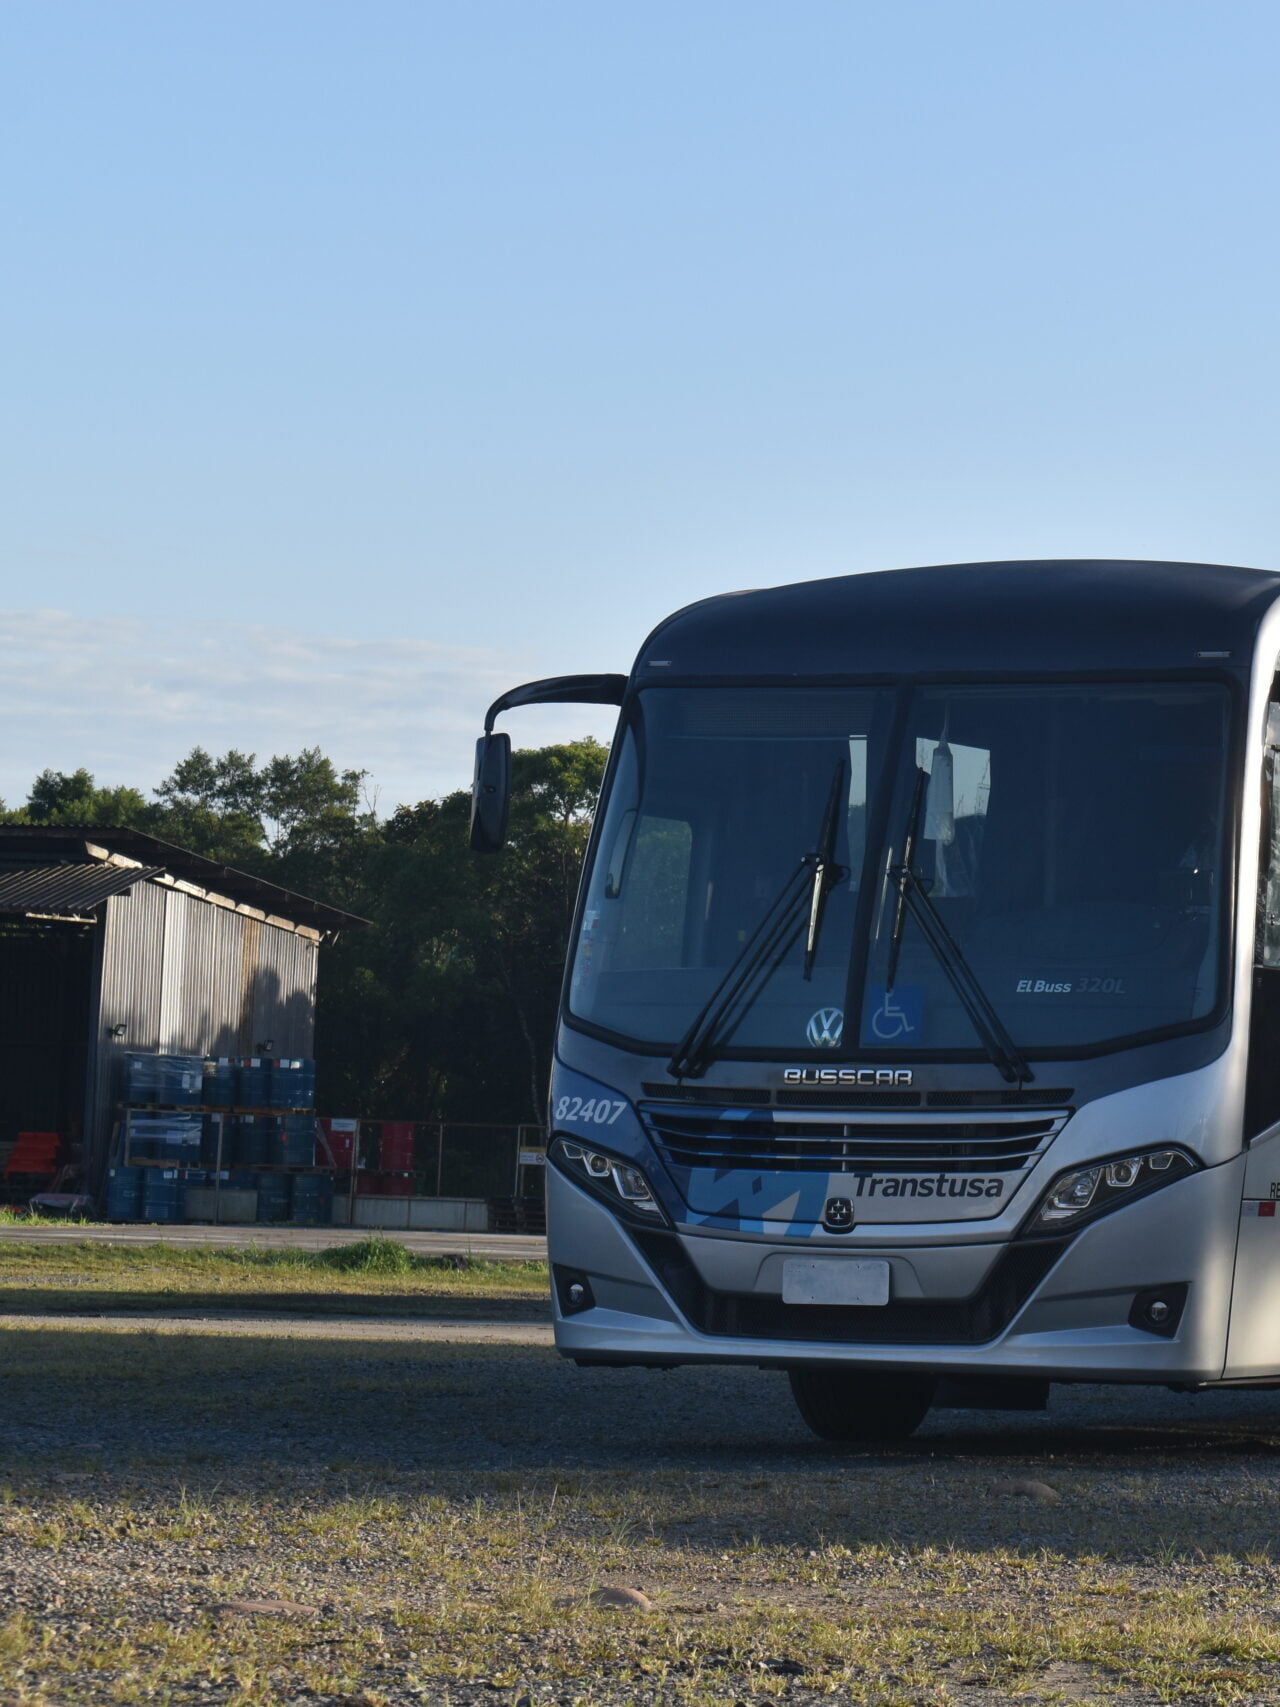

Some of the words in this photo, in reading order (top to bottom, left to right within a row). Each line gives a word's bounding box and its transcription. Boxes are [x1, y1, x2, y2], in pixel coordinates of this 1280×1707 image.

[1076, 977, 1127, 994] 320L
[783, 1068, 913, 1086] BUSSCAR
[555, 1095, 627, 1125] 82407
[853, 1172, 1004, 1198] Transtusa
